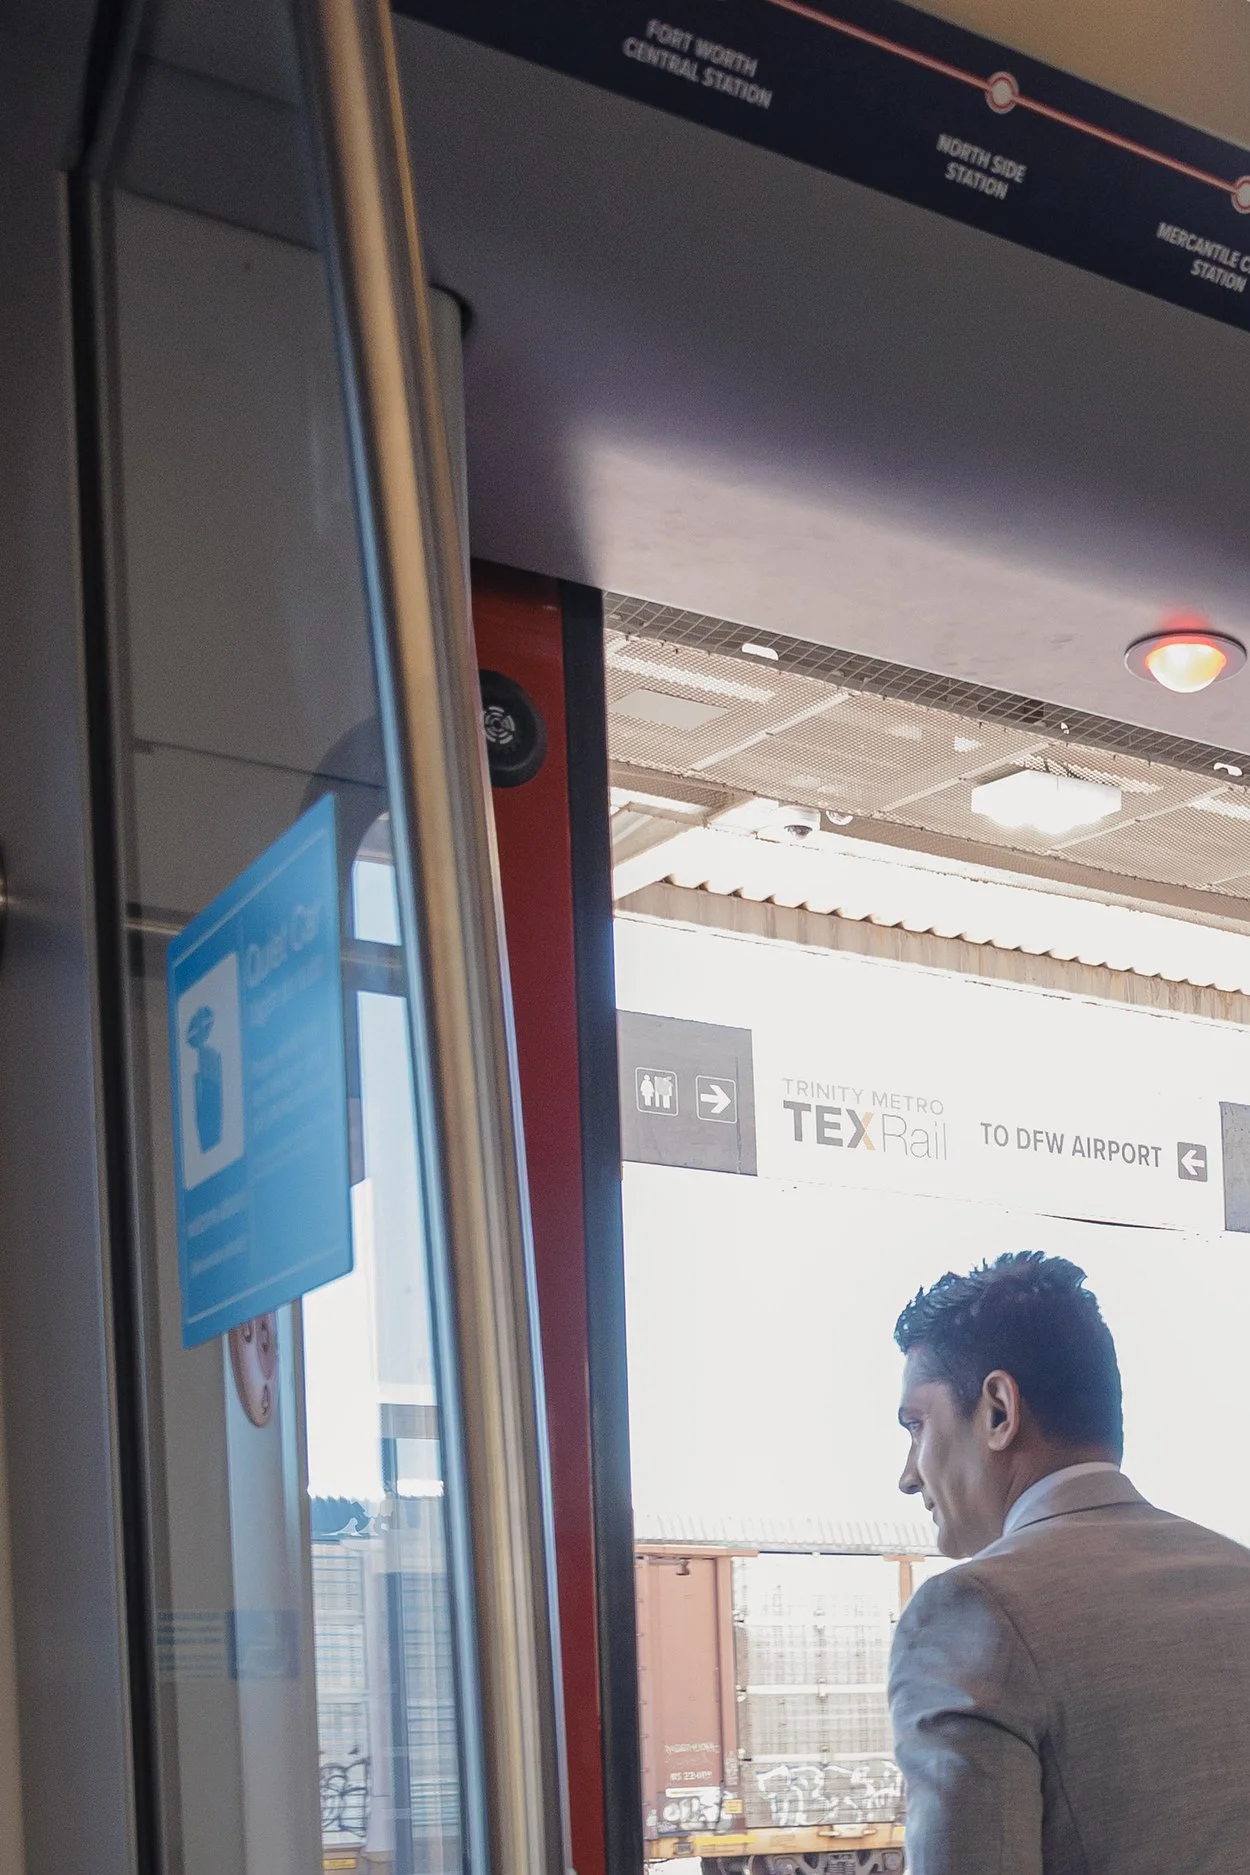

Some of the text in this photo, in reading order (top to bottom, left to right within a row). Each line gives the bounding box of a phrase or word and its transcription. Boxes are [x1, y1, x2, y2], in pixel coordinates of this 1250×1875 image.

[646, 18, 759, 79] FORT WORTH
[622, 36, 773, 109] CENTRAL STATION
[936, 133, 1027, 183] NORTH SIDE
[944, 161, 1009, 200] STATION
[1155, 221, 1242, 269] MERCANTILE
[1189, 258, 1247, 293] STATION
[782, 1077, 944, 1116] TRINITY METRO
[980, 1121, 1162, 1168] TO DFW AIRPORT
